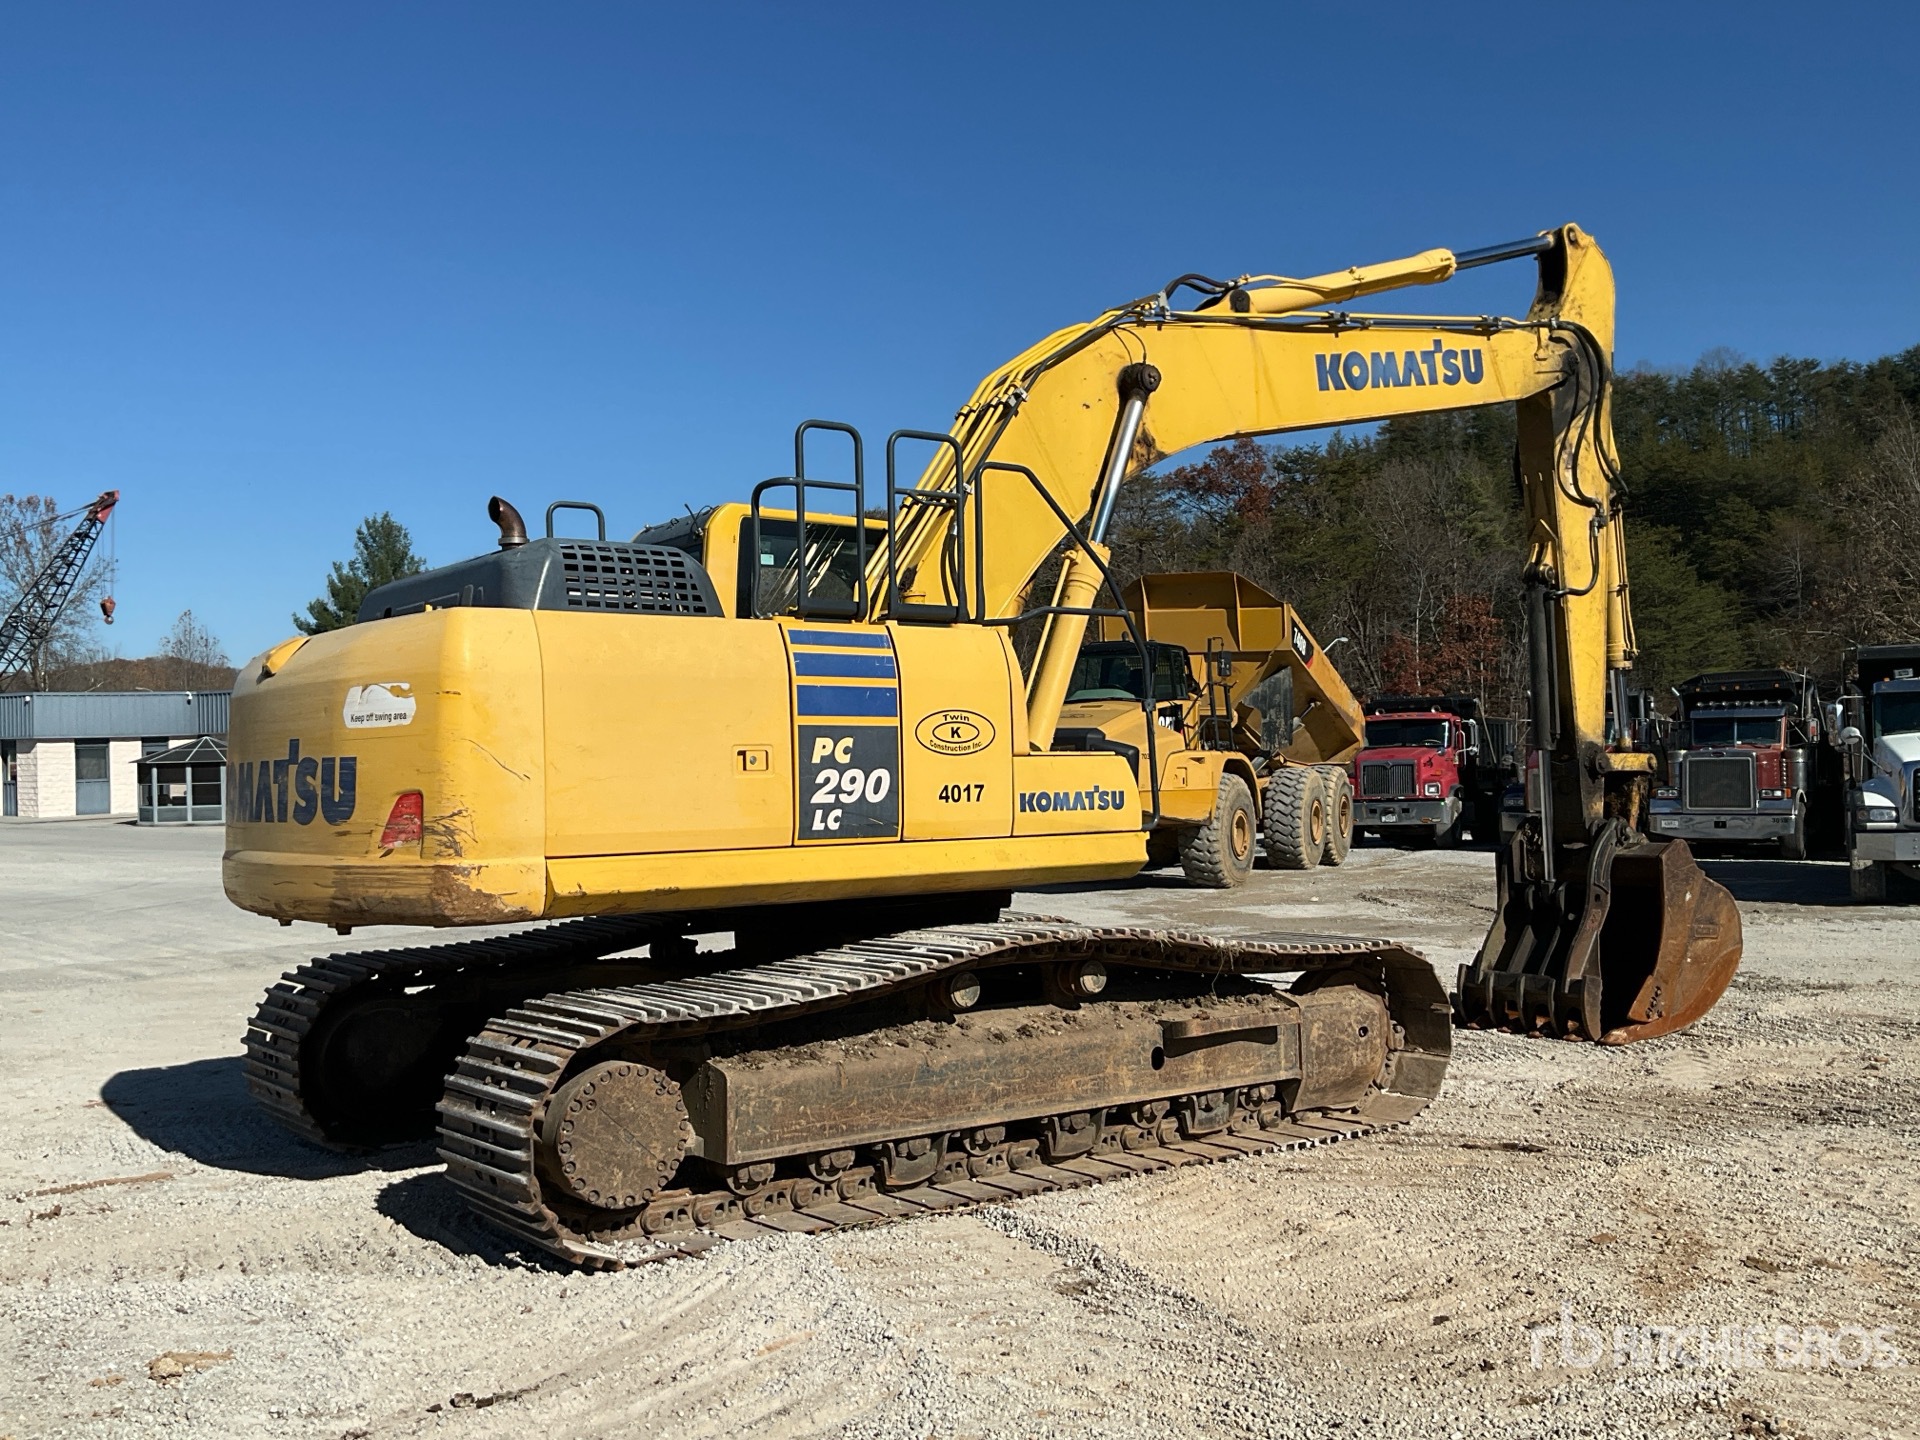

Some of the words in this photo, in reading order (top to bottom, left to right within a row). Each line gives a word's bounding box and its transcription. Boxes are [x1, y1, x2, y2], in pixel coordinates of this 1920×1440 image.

[1315, 339, 1484, 391] KOMATSU
[350, 714, 364, 724] Keep
[366, 713, 374, 722] off
[375, 712, 392, 723] swing
[393, 712, 407, 720] area
[942, 713, 970, 722] Twin
[950, 726, 962, 739] K
[811, 736, 854, 764] PC
[929, 739, 971, 752] Construction
[227, 738, 357, 826] OMATSU
[809, 768, 891, 804] 290
[938, 783, 985, 803] 4017
[1019, 785, 1125, 813] KOMATSU
[811, 808, 843, 831] LC
